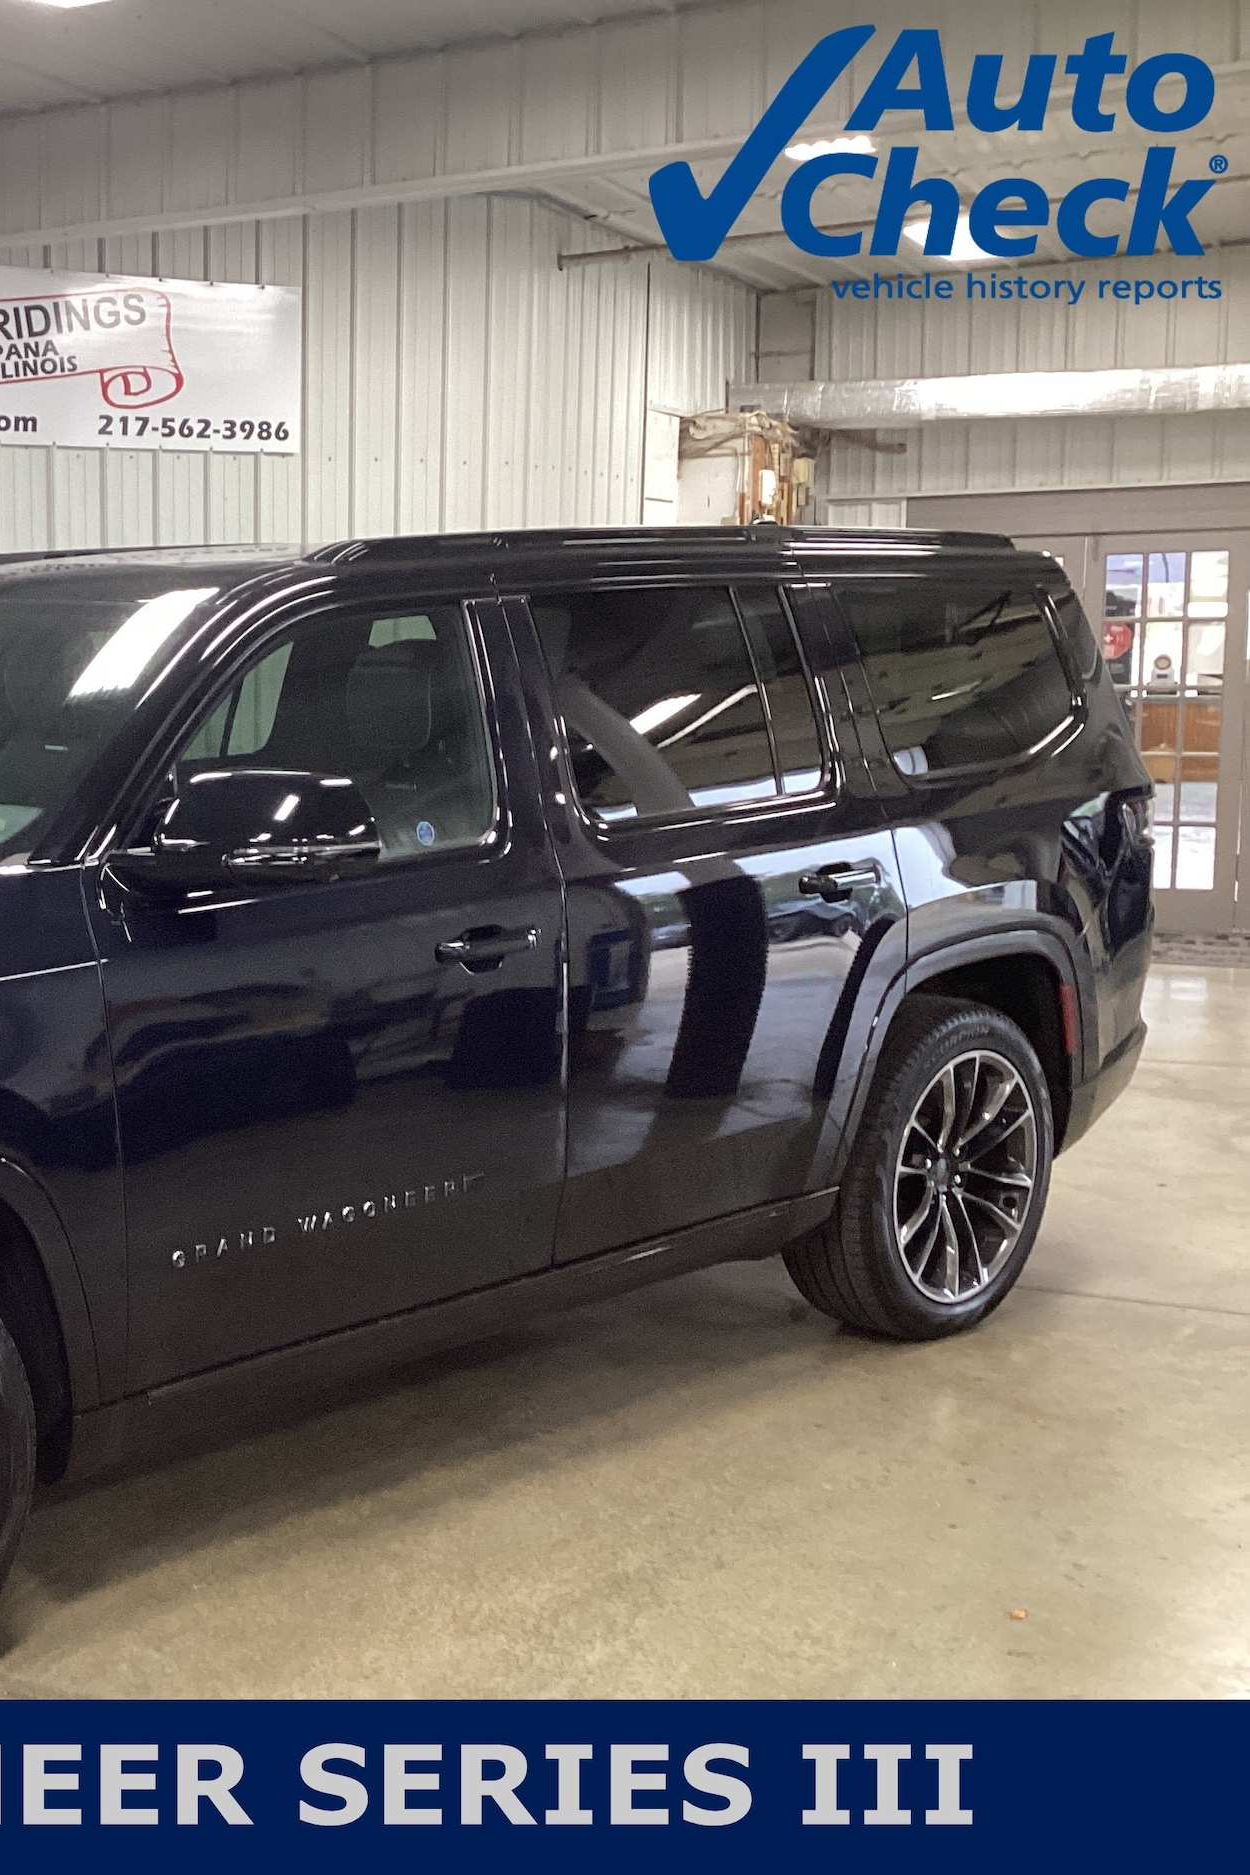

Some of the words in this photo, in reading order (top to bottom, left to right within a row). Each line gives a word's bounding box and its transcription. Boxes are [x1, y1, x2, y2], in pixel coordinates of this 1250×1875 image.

[98, 415, 290, 442] 217-562-3986
[171, 1226, 276, 1268] GRAND
[298, 1181, 455, 1232] WAGONEER
